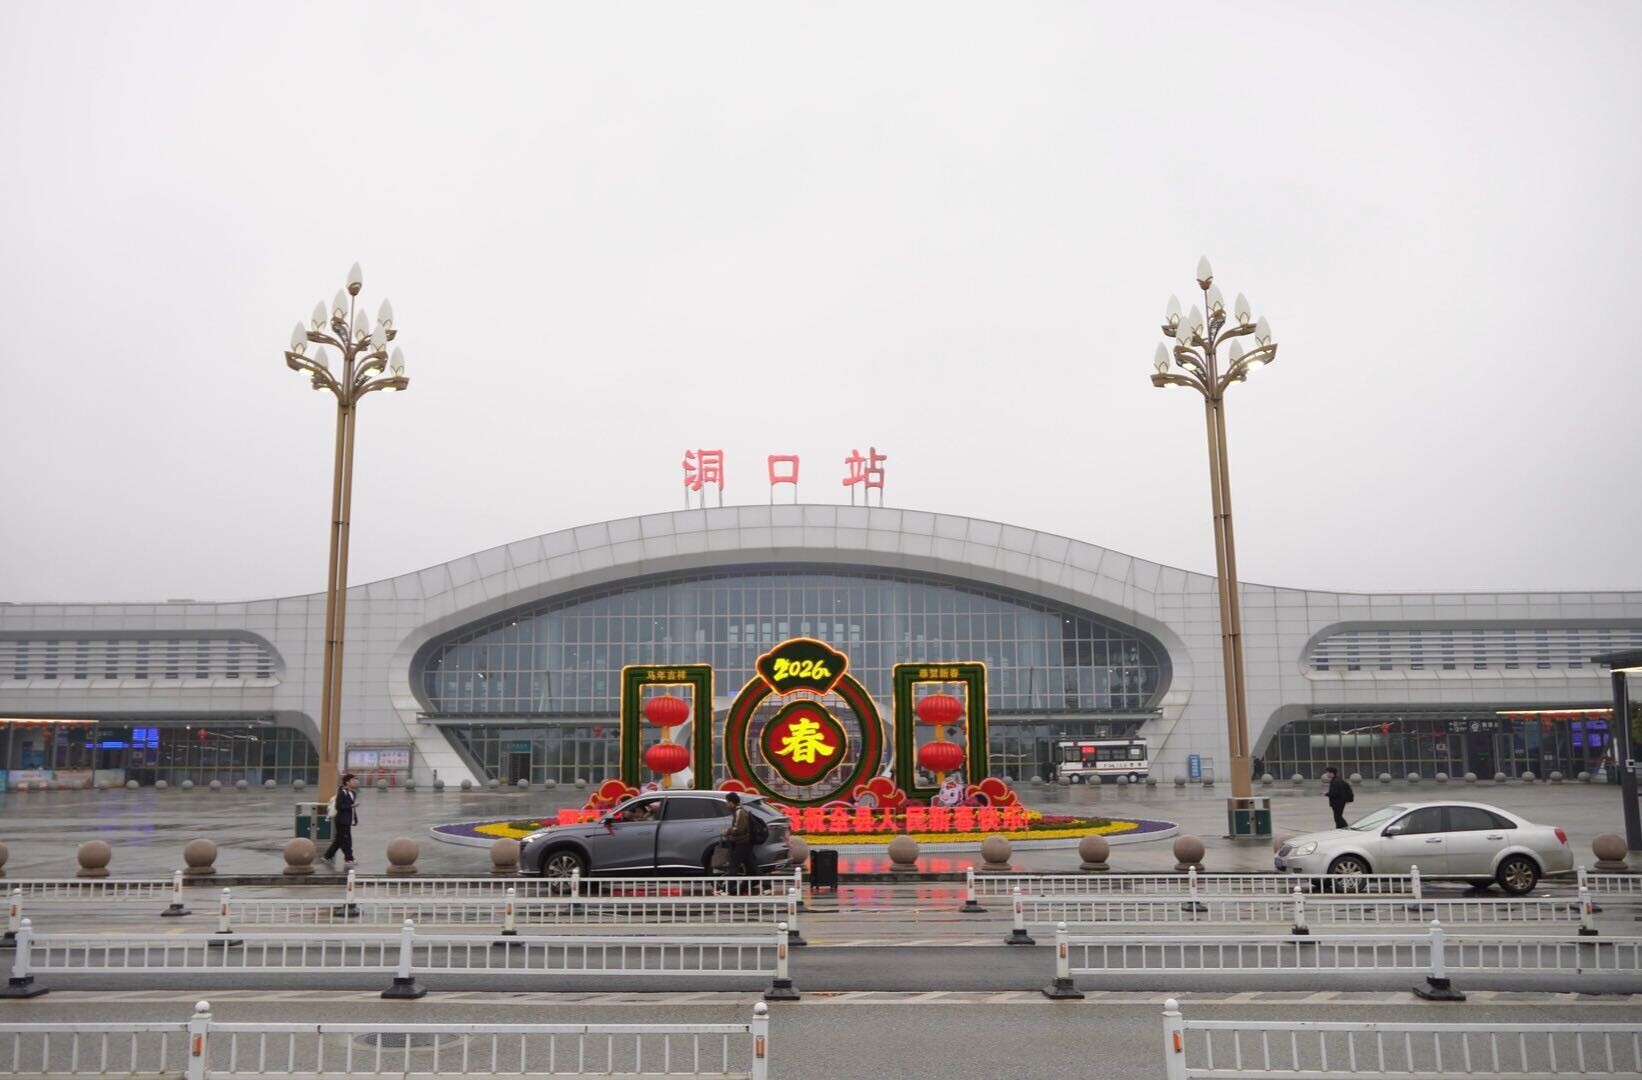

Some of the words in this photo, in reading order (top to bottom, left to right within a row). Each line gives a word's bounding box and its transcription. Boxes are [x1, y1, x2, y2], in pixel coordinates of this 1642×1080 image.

[682, 447, 887, 491] 洞口站
[646, 670, 687, 680] 马年吉祥
[773, 658, 831, 681] 2026
[774, 717, 836, 764] 春
